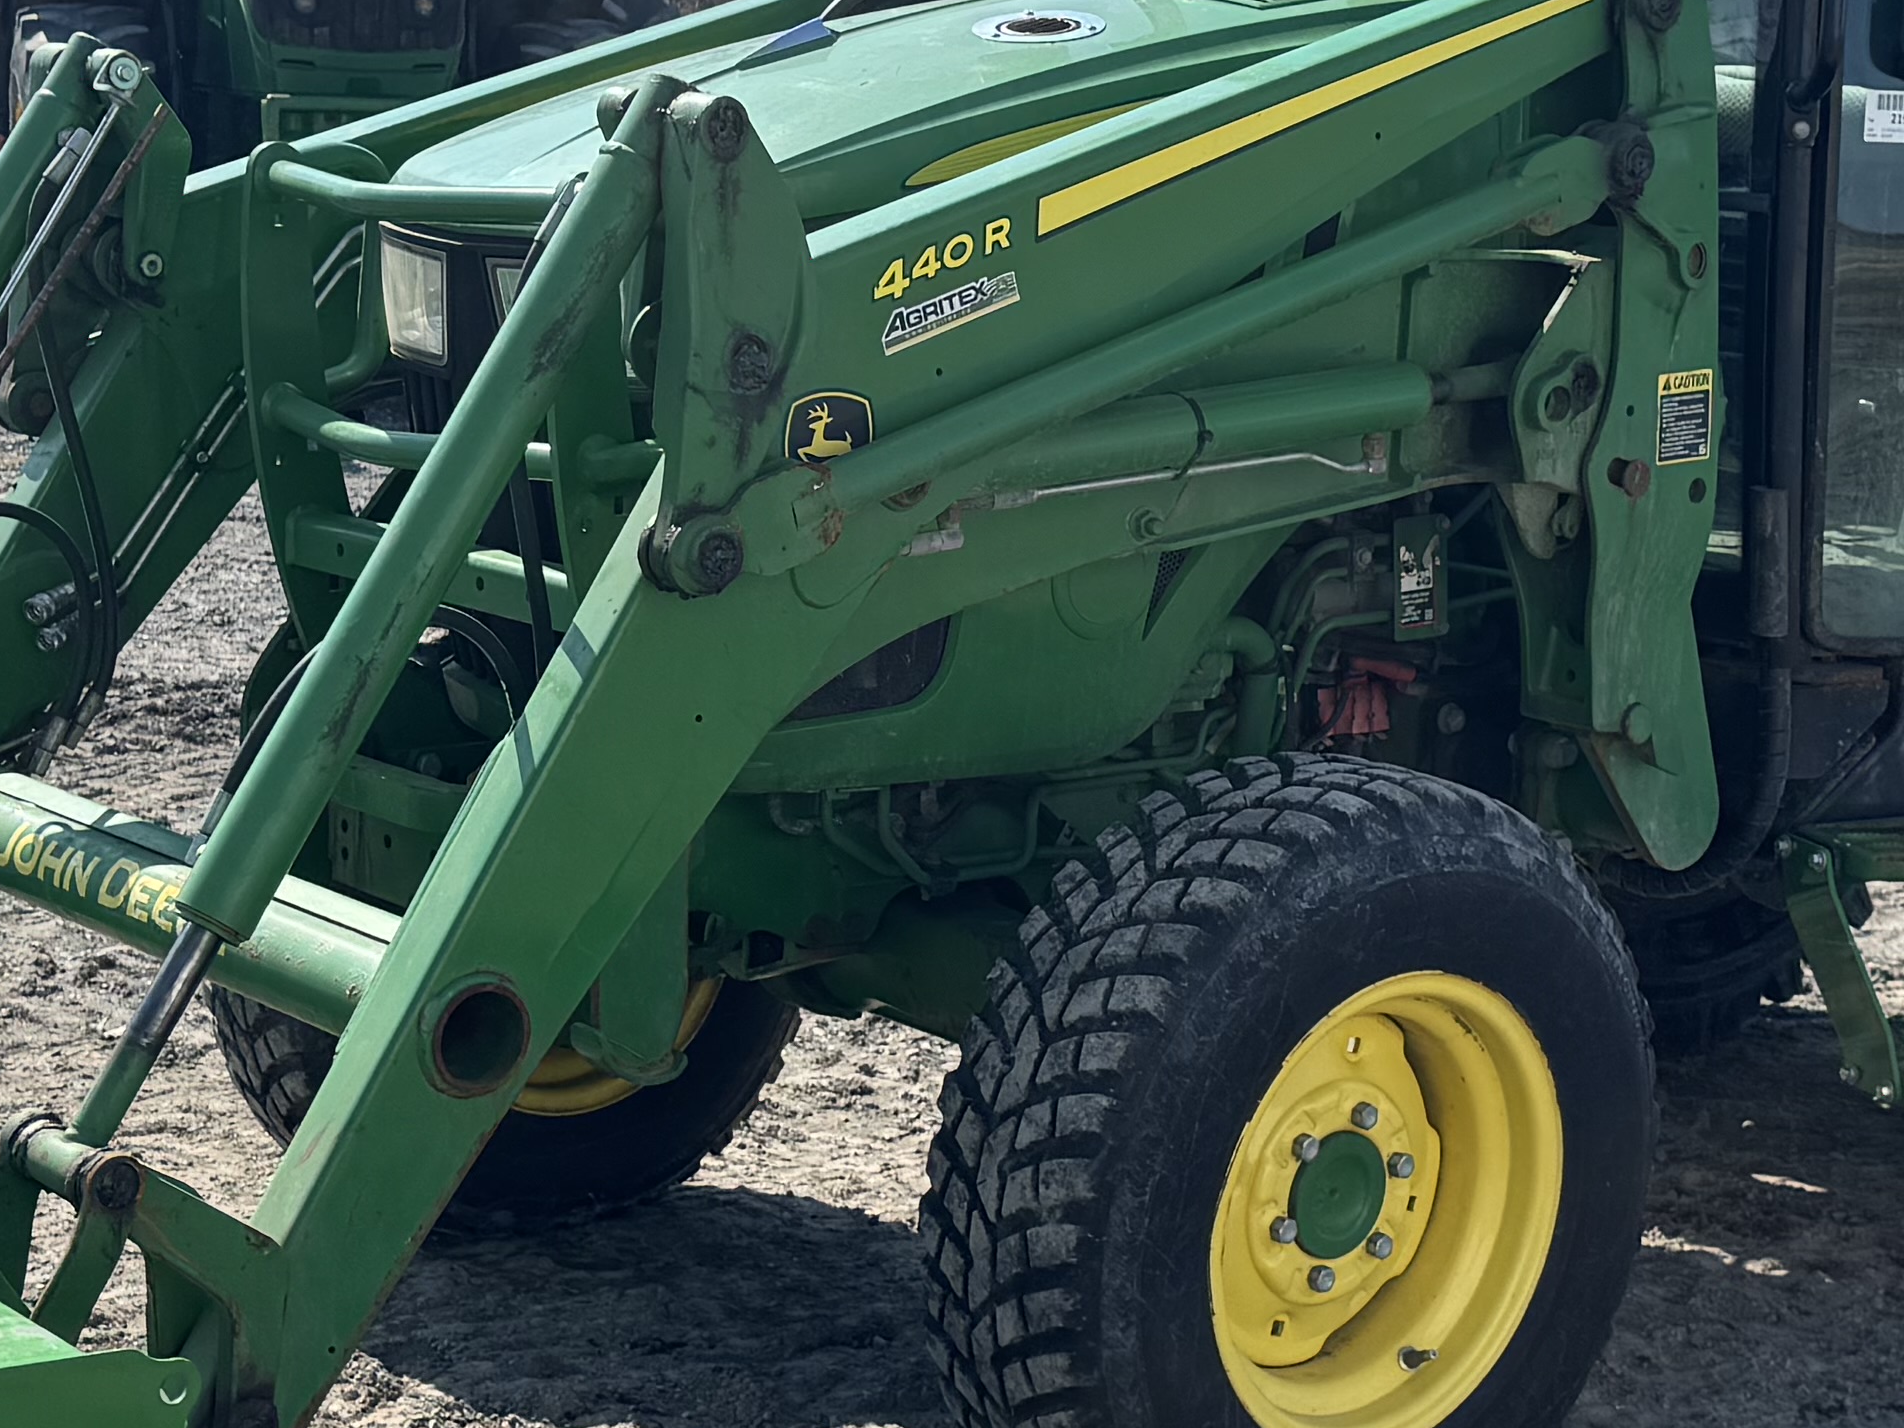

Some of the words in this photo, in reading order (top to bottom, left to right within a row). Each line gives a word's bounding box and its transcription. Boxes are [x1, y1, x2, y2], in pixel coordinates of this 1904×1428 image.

[874, 233, 974, 299] 440
[985, 217, 1011, 255] R
[885, 281, 988, 339] AGRITEX
[98, 858, 192, 936] DEE
